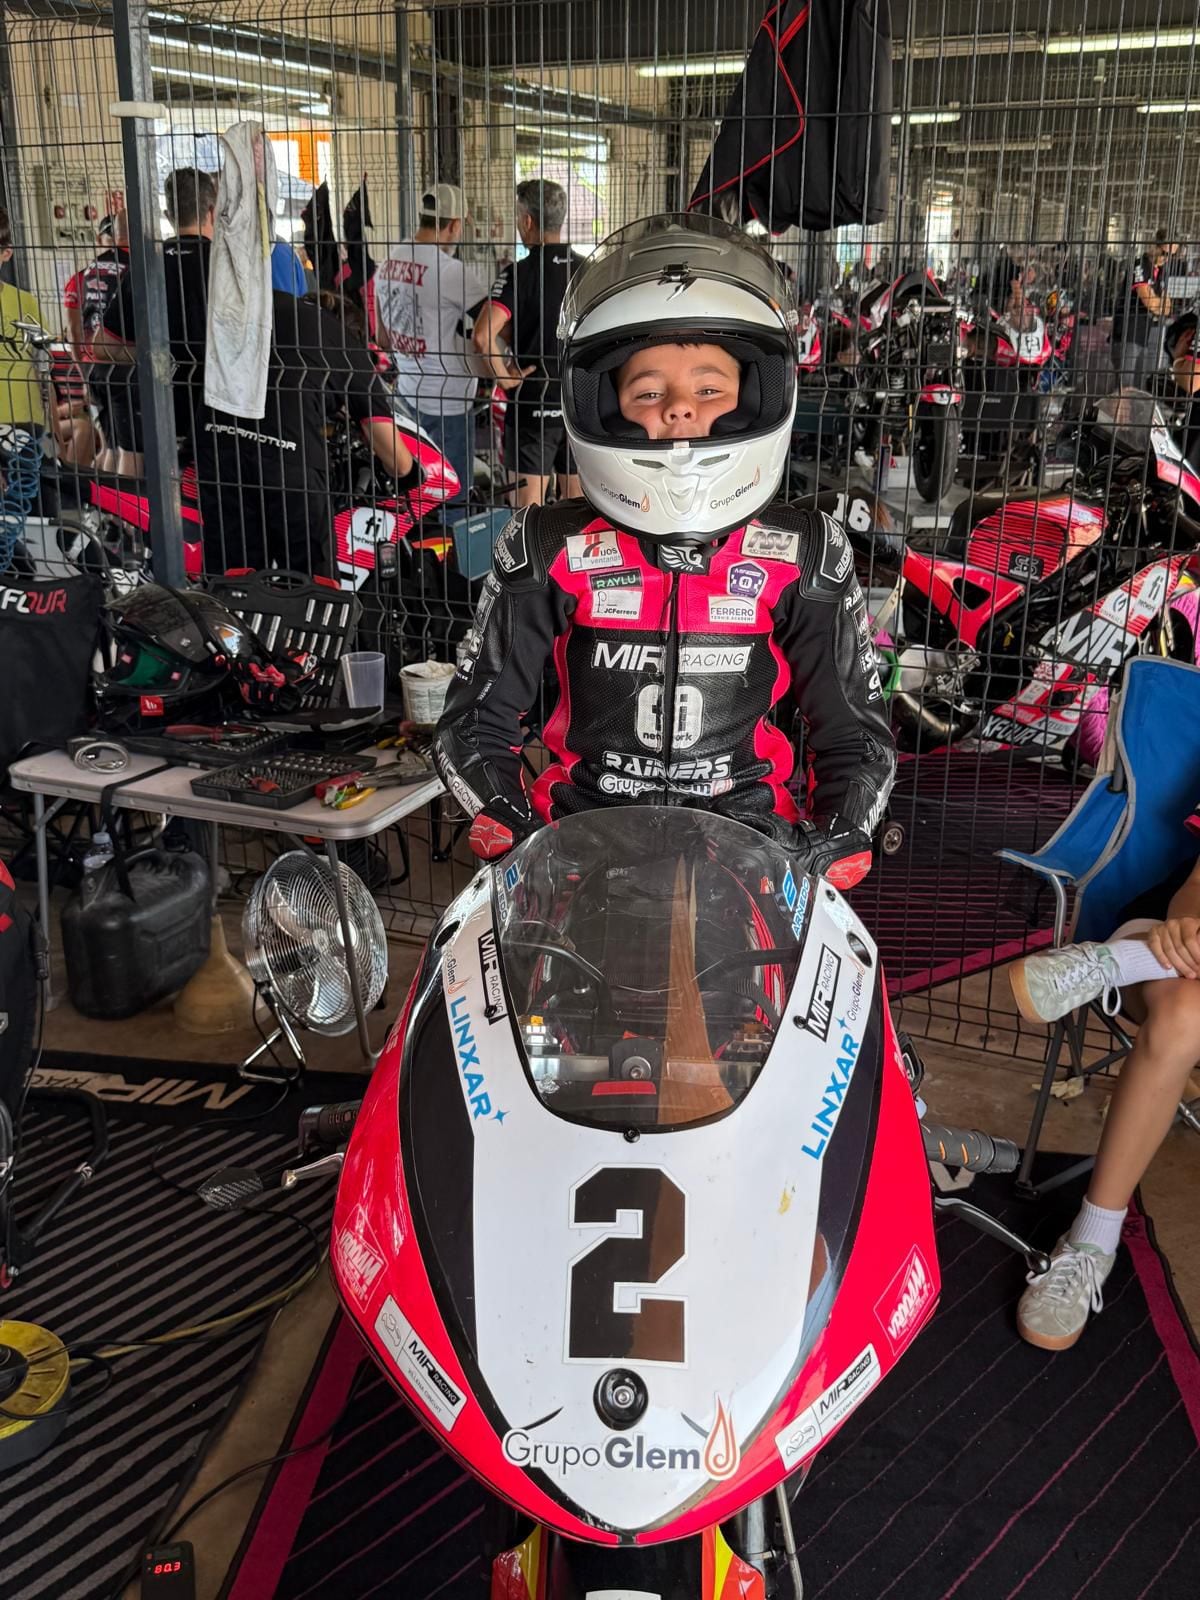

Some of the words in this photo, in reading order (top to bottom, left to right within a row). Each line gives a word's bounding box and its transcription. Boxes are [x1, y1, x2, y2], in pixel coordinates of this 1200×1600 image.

[831, 493, 871, 532] 16
[596, 574, 636, 589] RAYLU
[604, 608, 638, 616] JCFerrero
[711, 607, 754, 617] FERRERO
[681, 653, 745, 667] RACING
[792, 877, 810, 940] ARNEDO
[822, 953, 835, 992] RACING
[847, 971, 865, 1022] GrupoGlem
[451, 996, 492, 1120] LINXAR
[801, 1033, 859, 1160] LINXAR
[564, 1165, 688, 1364] 2
[408, 1340, 436, 1377] MIR
[432, 1373, 459, 1405] RACING
[819, 1382, 850, 1415] MIR
[504, 1432, 701, 1475] GrupoGlem
